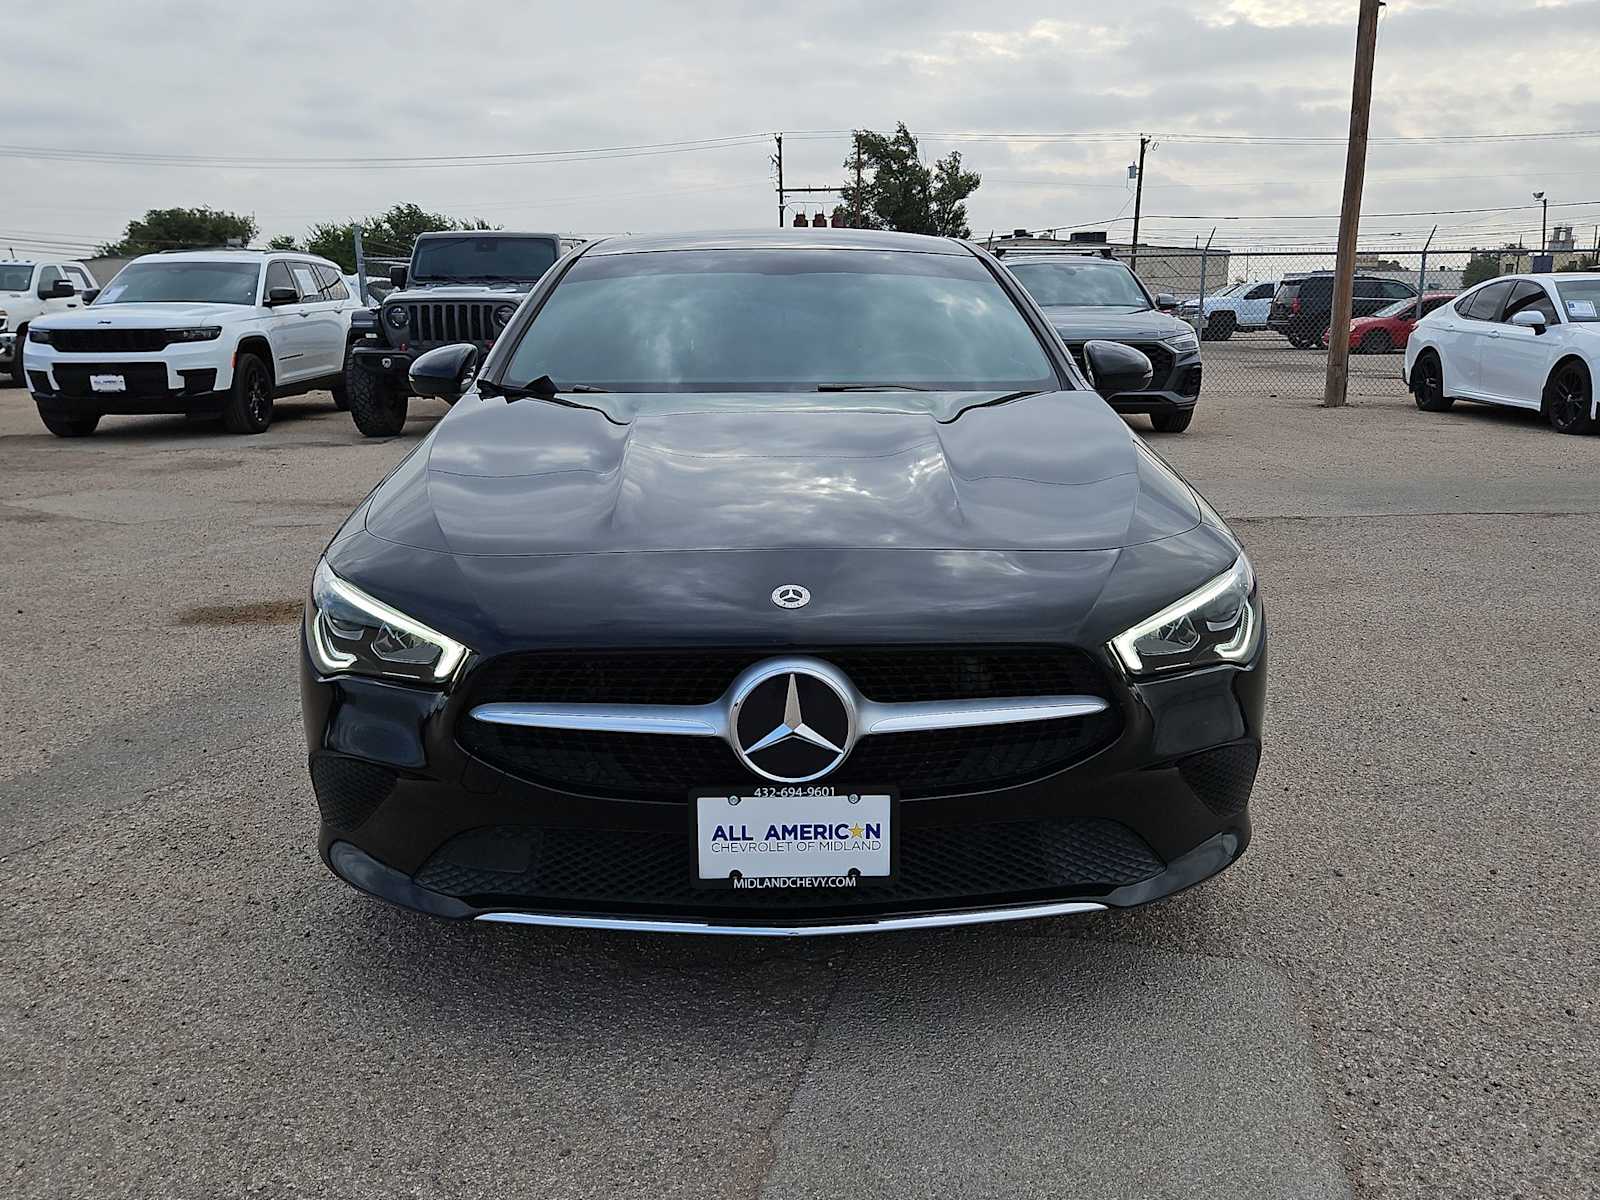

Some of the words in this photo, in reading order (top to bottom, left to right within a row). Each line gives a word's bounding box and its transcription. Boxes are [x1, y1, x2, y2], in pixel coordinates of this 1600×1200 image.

[754, 786, 835, 798] 432-694-9601
[711, 825, 754, 842] ALL
[764, 823, 881, 841] AMERICN
[711, 842, 793, 853] CHEVROLET
[796, 841, 815, 852] OF
[819, 840, 882, 851] MIDLAND
[733, 876, 856, 889] MIDLANDCHEVY.COM
